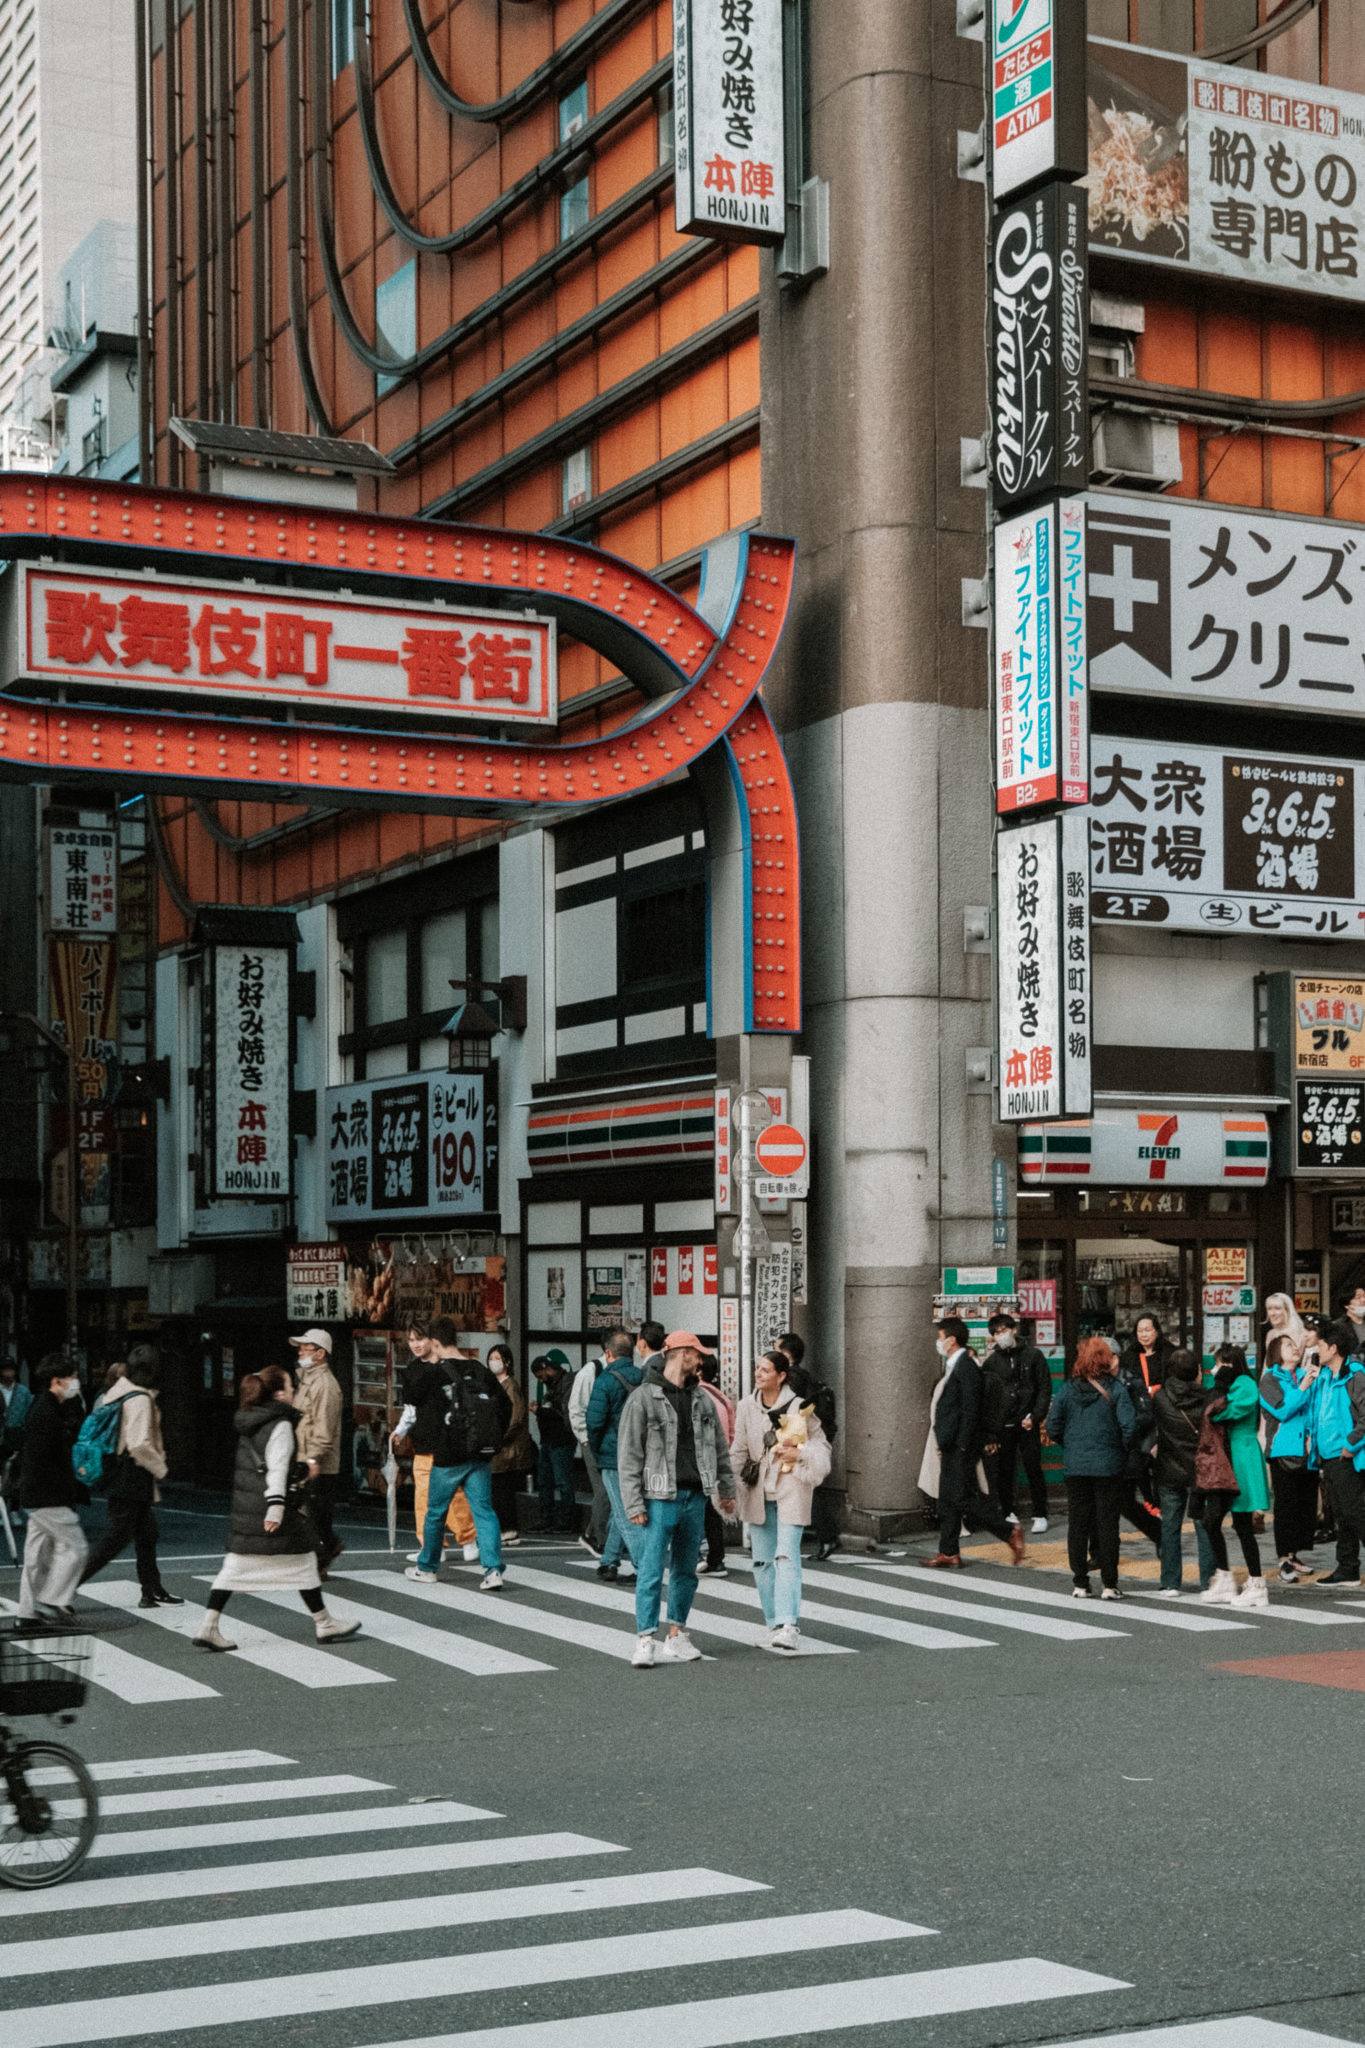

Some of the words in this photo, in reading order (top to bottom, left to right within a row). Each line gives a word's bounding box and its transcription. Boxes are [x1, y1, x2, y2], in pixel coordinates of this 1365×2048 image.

[1003, 39, 1043, 82] たばこ
[1014, 75, 1032, 106] 酒
[1196, 80, 1336, 135] 歌舞伎町名物
[1006, 101, 1040, 141] ATM
[1342, 116, 1365, 138] HON
[703, 153, 775, 200] 本陣
[1208, 125, 1358, 208] 粉もの
[706, 195, 770, 226] HONJIN
[1209, 196, 1359, 279] 専門店
[1059, 249, 1085, 376] Sparkle
[993, 210, 1053, 494] Sparkle
[1022, 304, 1054, 489] スパークル
[1063, 379, 1085, 469] スパークル
[1037, 519, 1048, 586] ボクシング
[1187, 525, 1365, 605] メンズ
[1062, 529, 1085, 697] ファイトフィット
[44, 589, 533, 704] 歌舞伎町一番街
[1013, 564, 1034, 776] ファイトフィット
[1038, 601, 1049, 699] キックボクシング
[1187, 613, 1365, 694] クリニ
[1001, 649, 1014, 779] 新宿東口駅前
[1039, 705, 1050, 766] ダイエット
[1069, 700, 1080, 777] 新宿東口駅前
[1015, 783, 1039, 806] B2F
[1064, 785, 1086, 799] B2F
[1091, 753, 1207, 816] 大衆
[1090, 819, 1207, 881] 酒場
[1256, 840, 1320, 891] 酒場
[65, 848, 89, 928] 東南荘
[1105, 895, 1151, 918] 2F
[1016, 842, 1041, 1038] お好み焼き
[1066, 871, 1087, 1060] 歌舞伎町名物
[80, 944, 105, 1060] ハイボール
[1298, 981, 1364, 996] 全国チェーンの店
[1316, 998, 1346, 1020] 麻雀
[237, 953, 266, 1092] お好み焼き
[1005, 1045, 1053, 1089] 本陣
[1298, 1053, 1329, 1067] 新宿店
[79, 1110, 105, 1126] 1F
[330, 1098, 369, 1150] 大衆
[1007, 1088, 1050, 1116] HONJIN
[78, 1132, 105, 1148] 2F
[236, 1099, 268, 1167] 本陣
[485, 1104, 498, 1169] 2F
[1315, 1123, 1348, 1146] 酒場
[1320, 1152, 1344, 1164] 2F
[225, 1170, 281, 1189] HONJIN
[330, 1155, 369, 1207] 酒場
[384, 1155, 414, 1198] 酒場
[432, 1130, 476, 1189] 190
[759, 1182, 804, 1195] 自転車を除く
[995, 1227, 1006, 1238] 17
[1207, 1248, 1246, 1259] ATM
[653, 1252, 718, 1284] たばこ
[1018, 1288, 1053, 1312] SIM
[1202, 1288, 1234, 1306] たばこ
[1239, 1288, 1254, 1306] 酒
